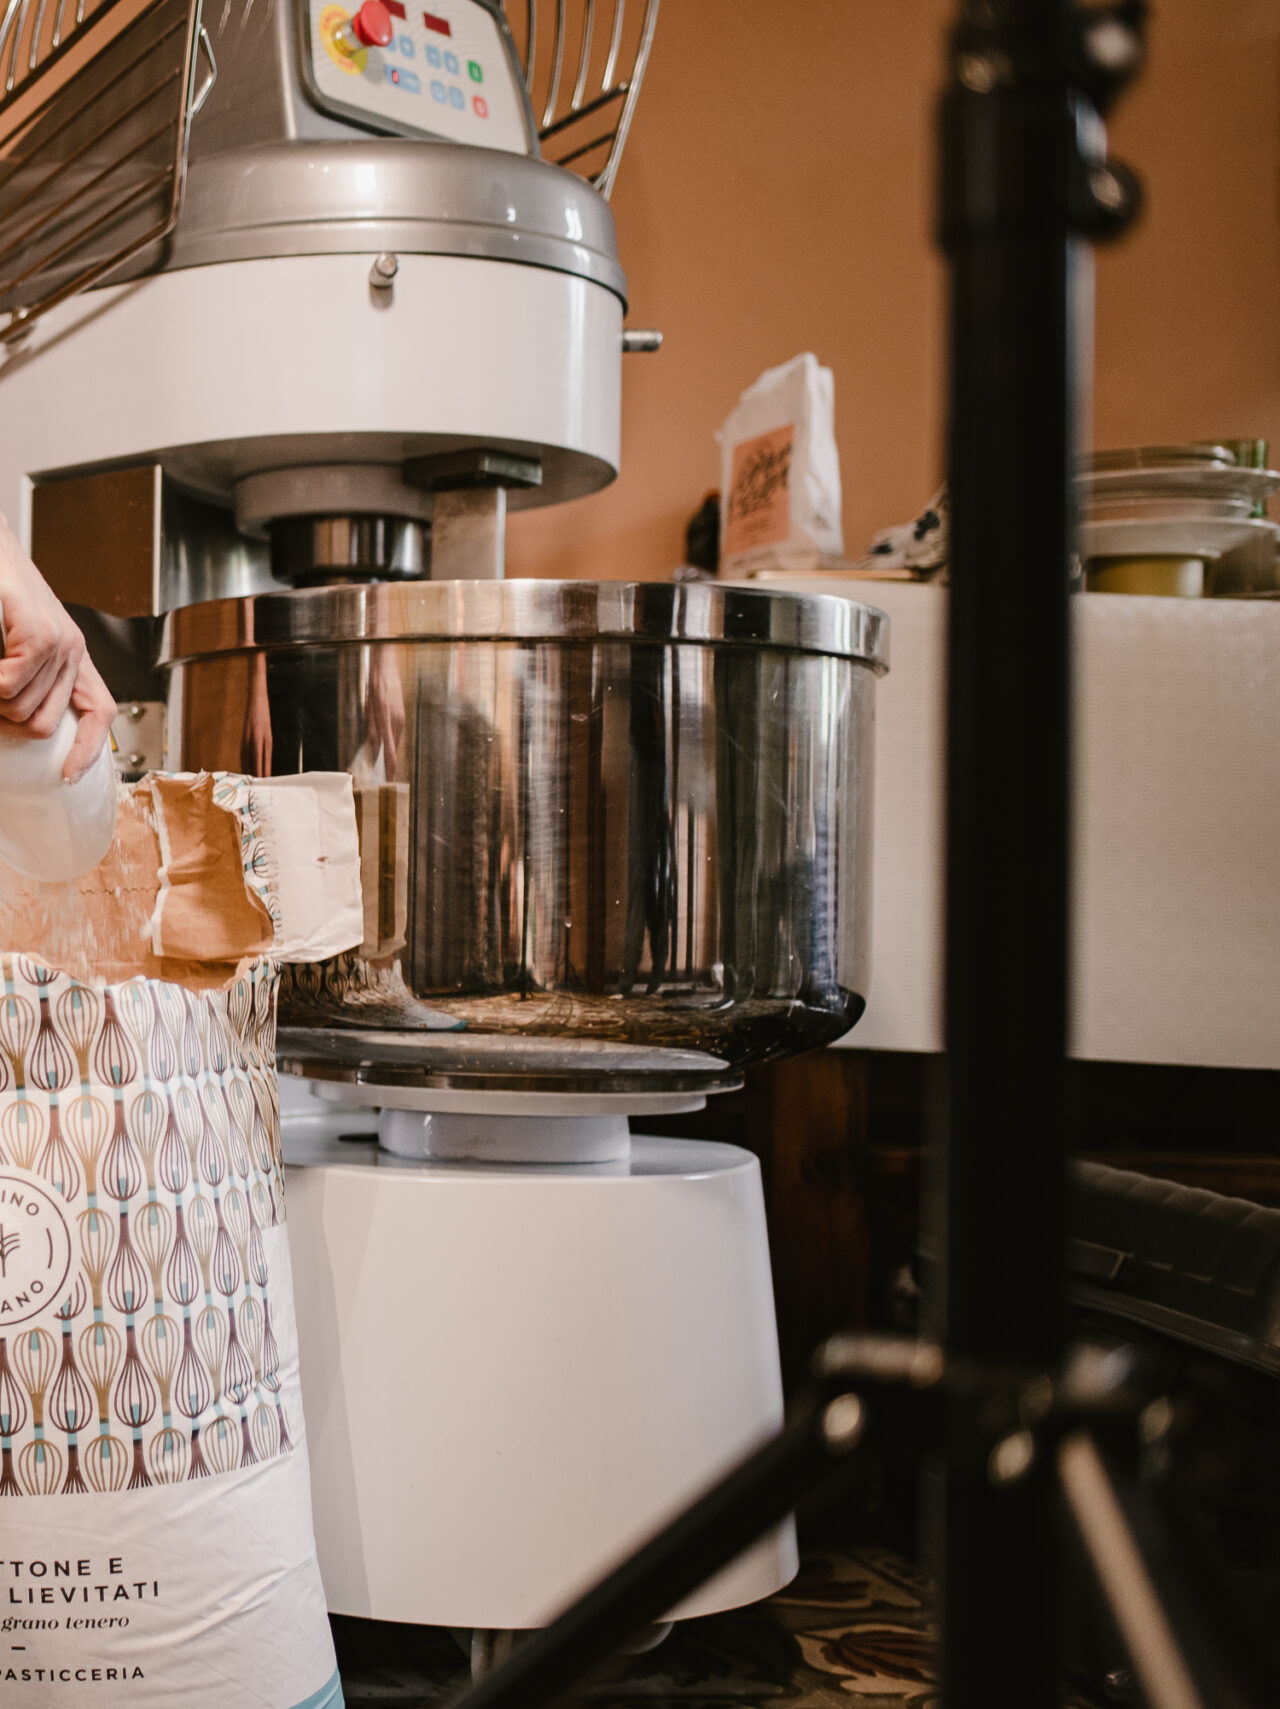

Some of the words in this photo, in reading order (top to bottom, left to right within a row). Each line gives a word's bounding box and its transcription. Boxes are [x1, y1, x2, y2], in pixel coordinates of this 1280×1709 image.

[109, 1557, 124, 1574] E
[9, 1581, 159, 1604] LIEVITATI
[1, 1616, 59, 1632] grano
[65, 1614, 130, 1630] tenero
